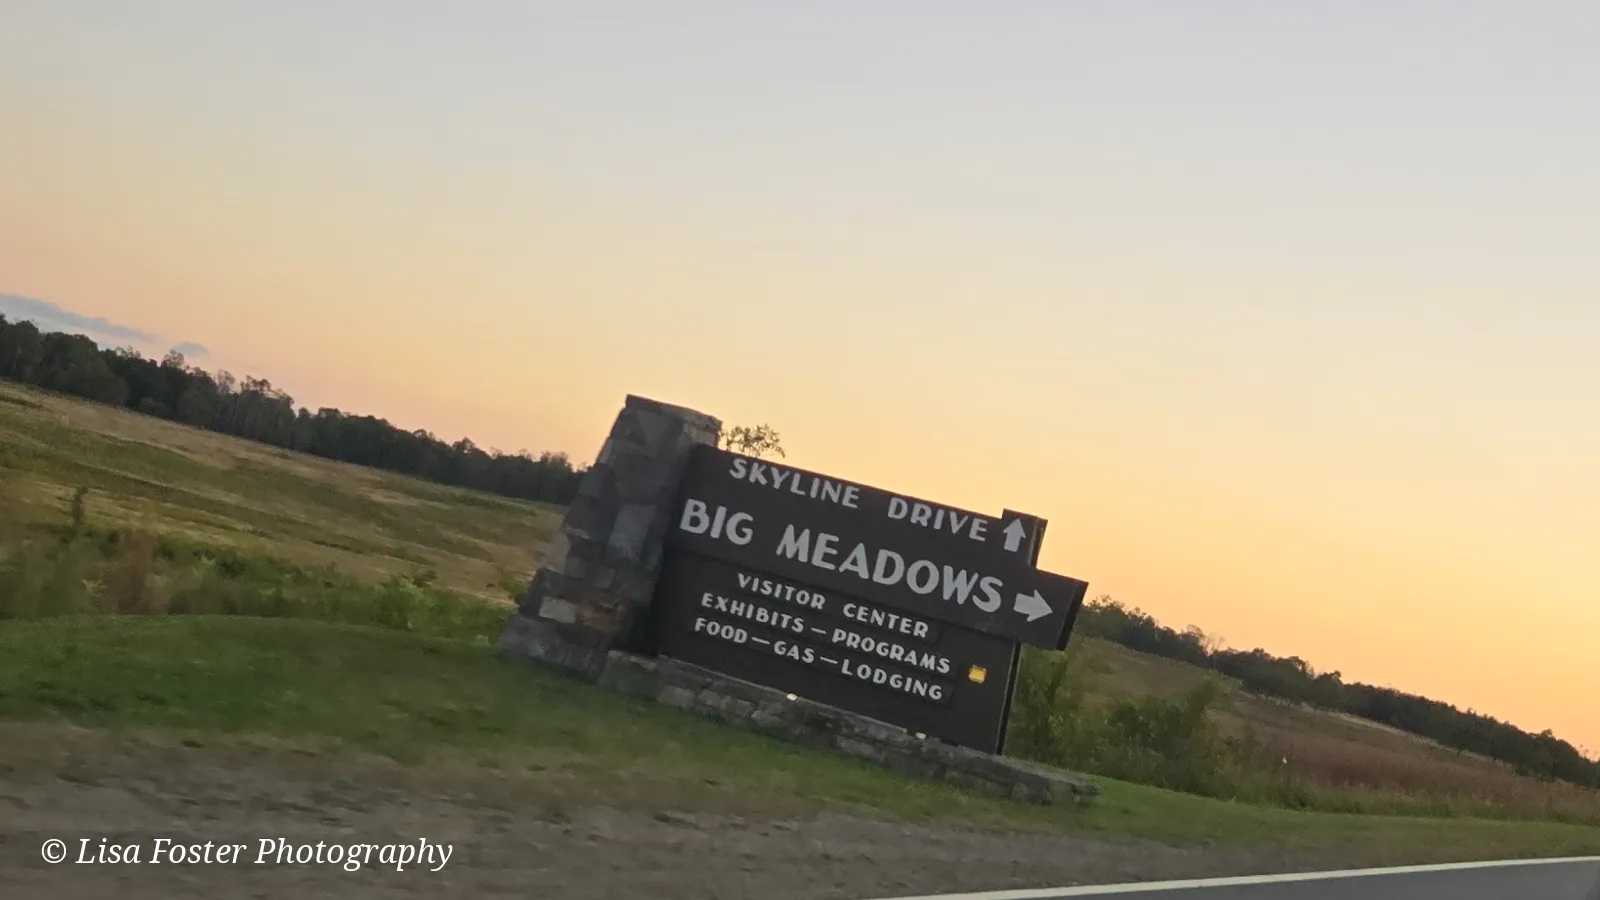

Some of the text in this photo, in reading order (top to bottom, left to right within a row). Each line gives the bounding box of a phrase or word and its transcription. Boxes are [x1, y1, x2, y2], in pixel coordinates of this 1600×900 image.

[729, 458, 989, 542] SKYLINE DRIVE
[680, 498, 1003, 613] BIG MEADOWS
[701, 592, 804, 634] EXHIBITS
[831, 628, 951, 674] PROGRAMS
[737, 572, 929, 638] VISITOR CENTER
[694, 617, 748, 644] FOOD
[773, 640, 815, 664] GAS
[841, 658, 943, 700] LODGING
